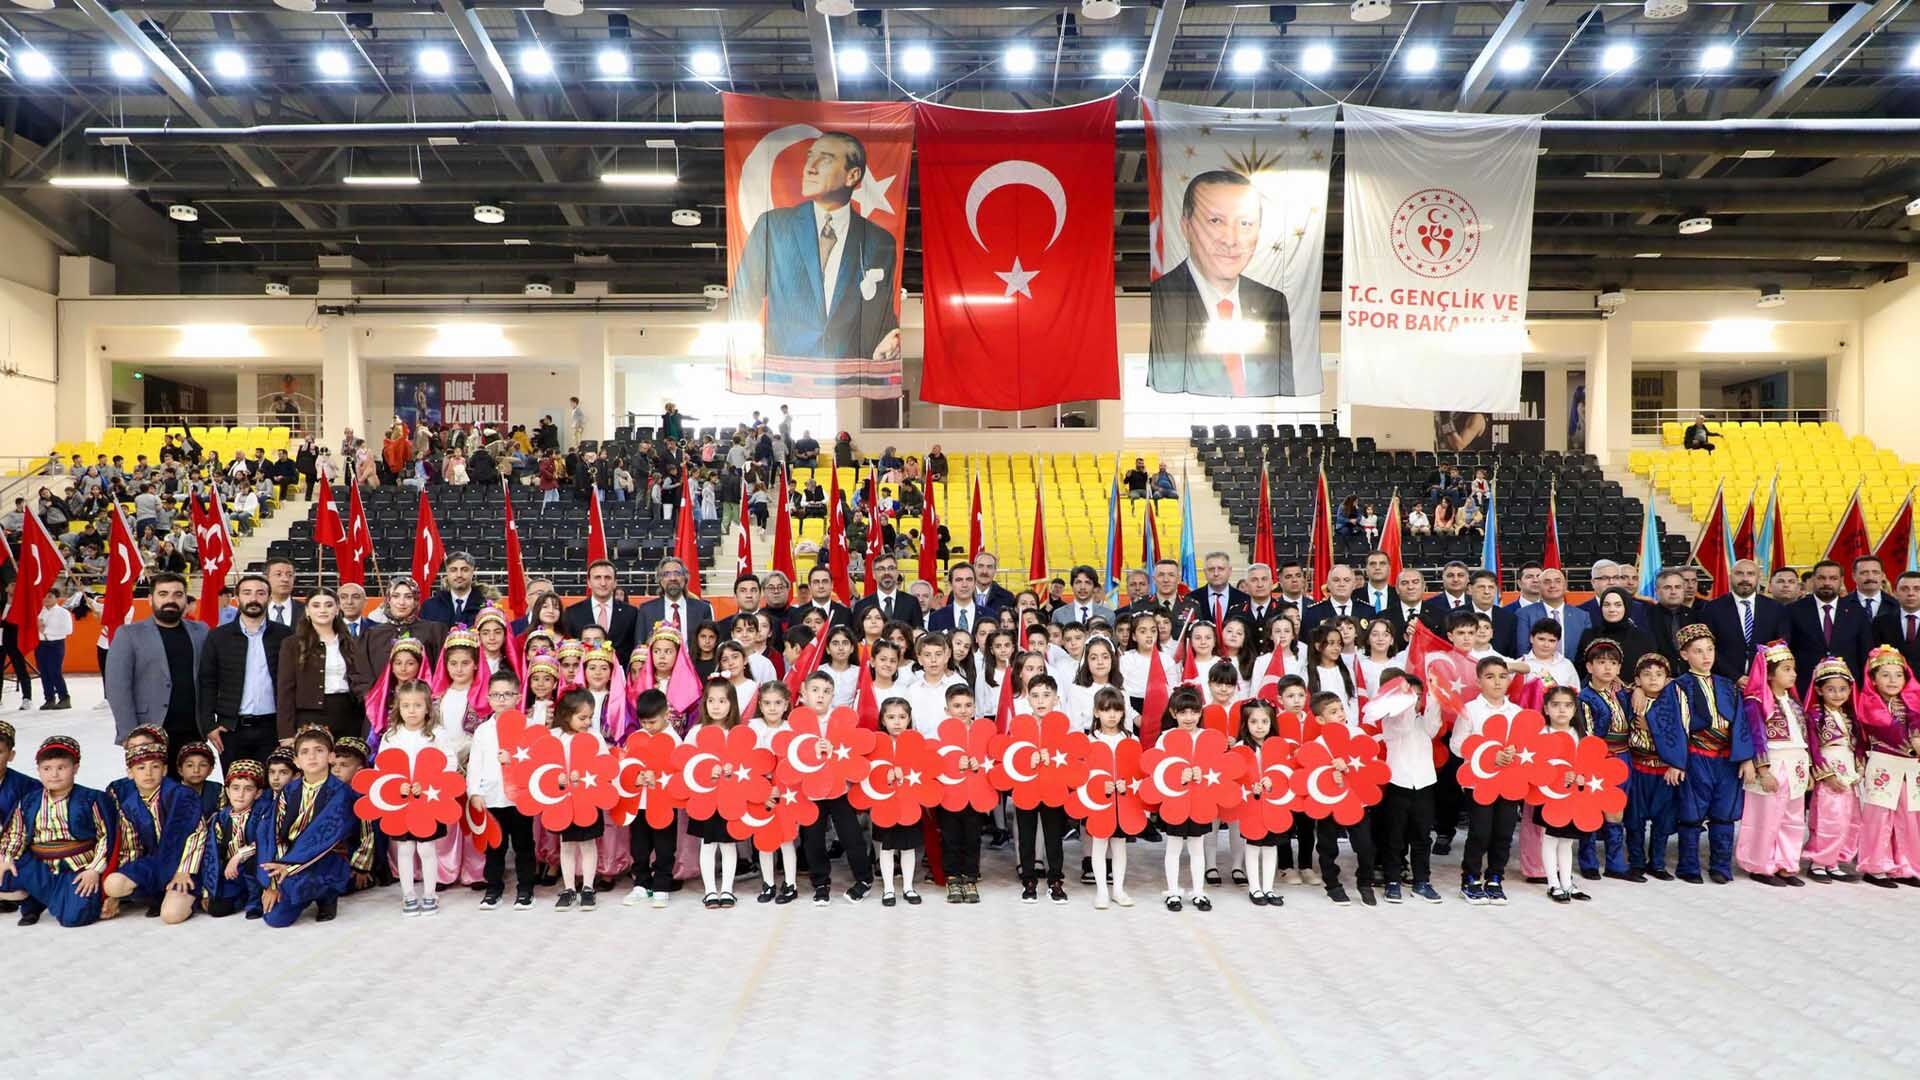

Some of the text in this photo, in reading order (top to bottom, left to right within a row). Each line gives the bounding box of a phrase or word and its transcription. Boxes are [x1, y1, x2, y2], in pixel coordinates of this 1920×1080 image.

[1349, 286, 1519, 312] T.C. GENÇLİK VE
[1348, 311, 1398, 329] SPOR
